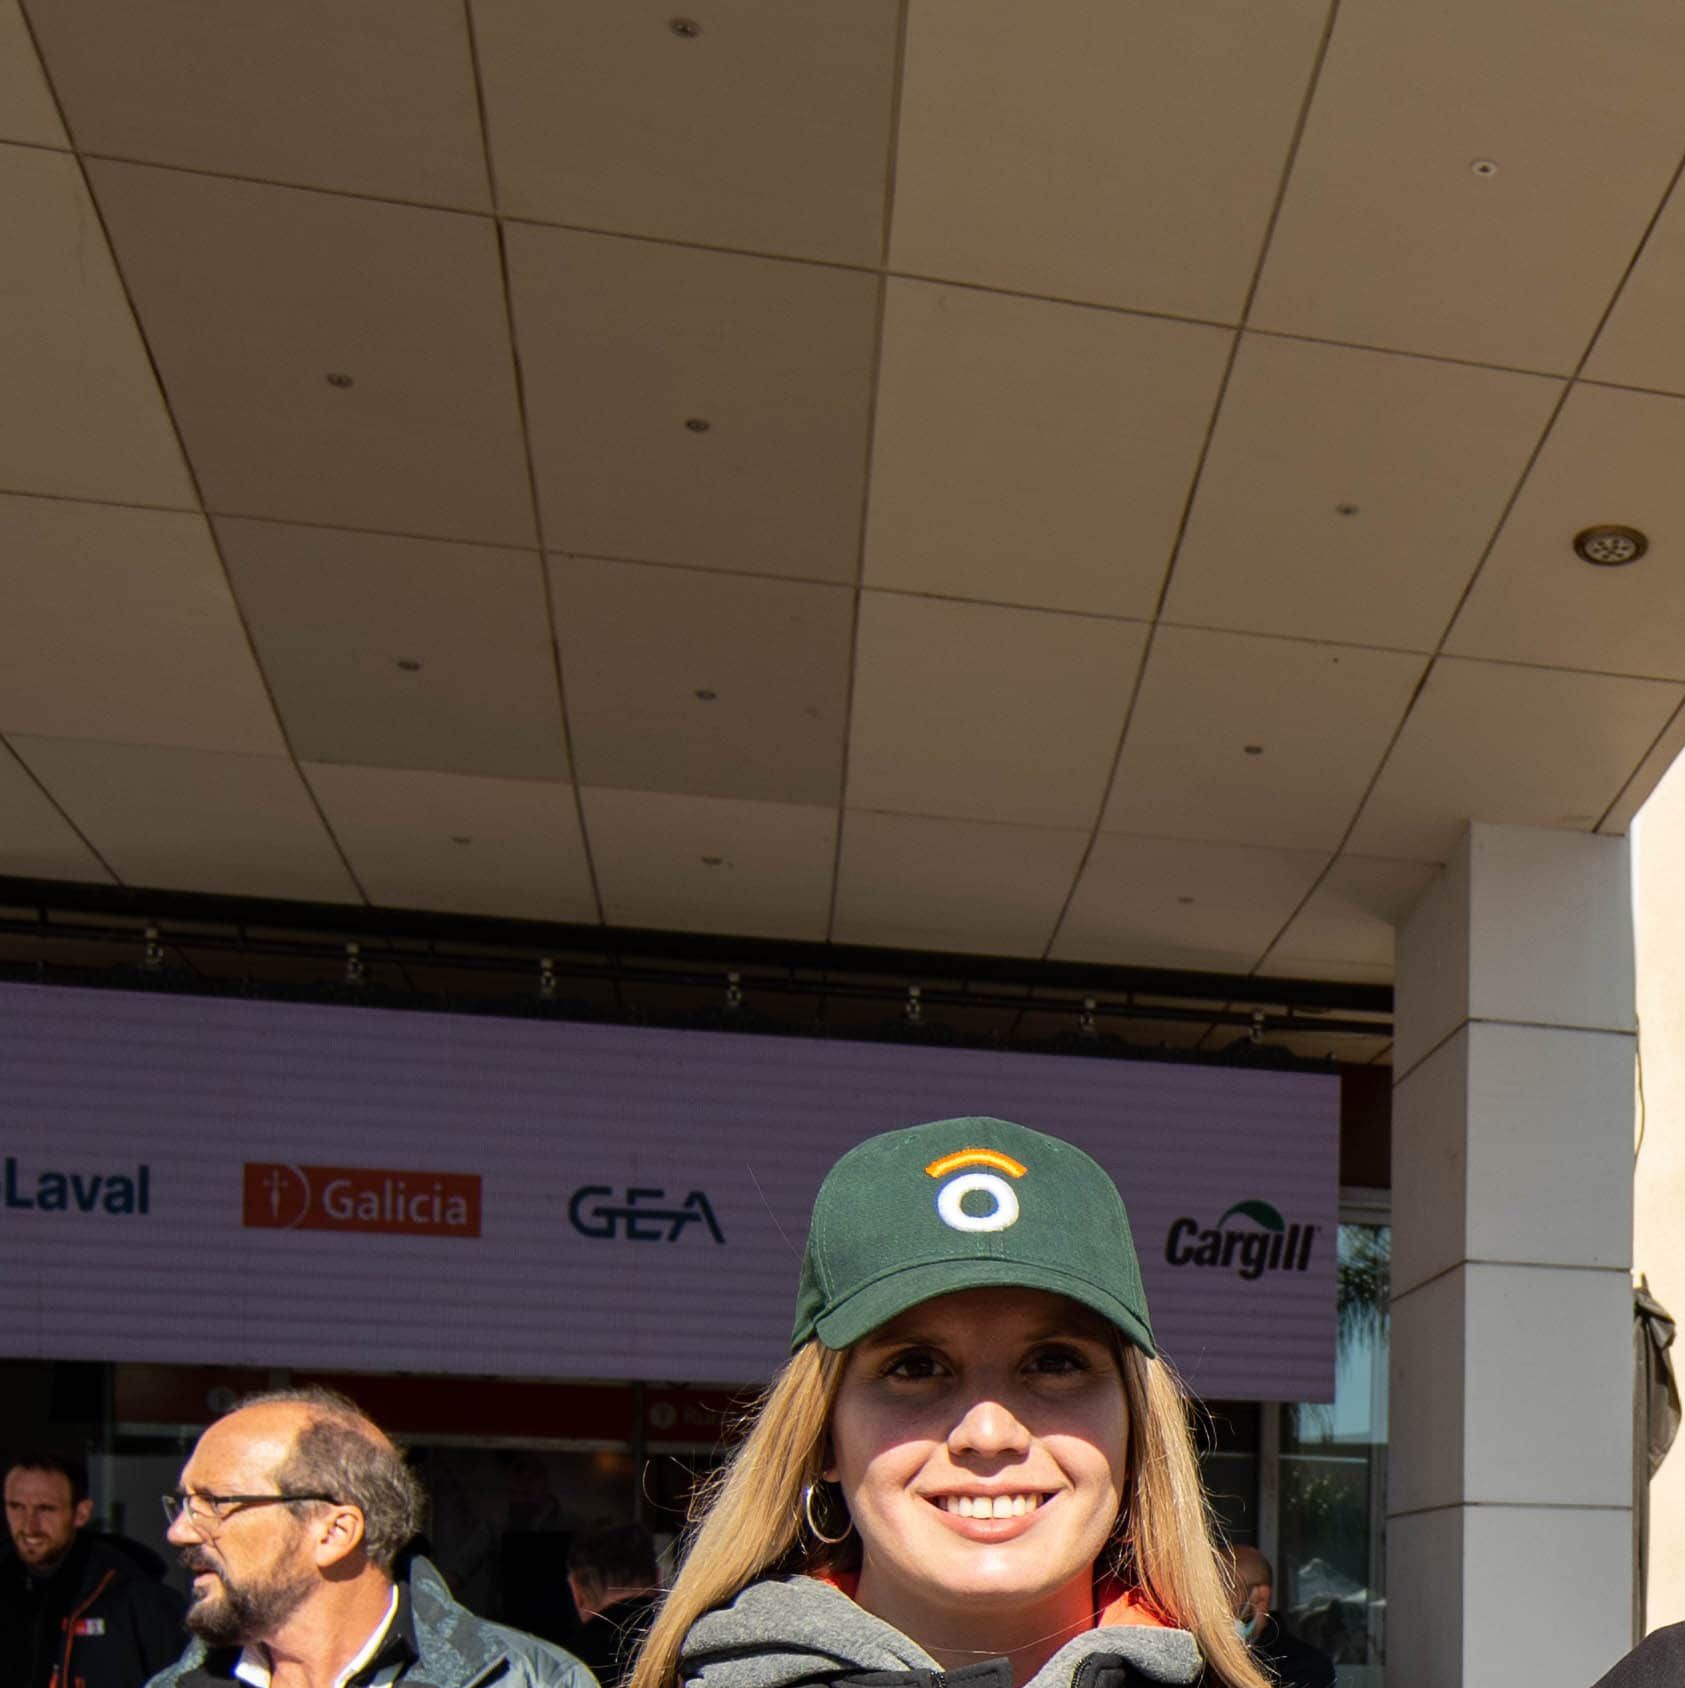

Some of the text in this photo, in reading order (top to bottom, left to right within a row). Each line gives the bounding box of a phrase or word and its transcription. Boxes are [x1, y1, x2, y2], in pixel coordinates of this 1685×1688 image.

[5, 1157, 150, 1214] Laval
[322, 1178, 468, 1227] Galicia
[568, 1185, 726, 1245] GEA
[1165, 1216, 1315, 1280] Cargill
